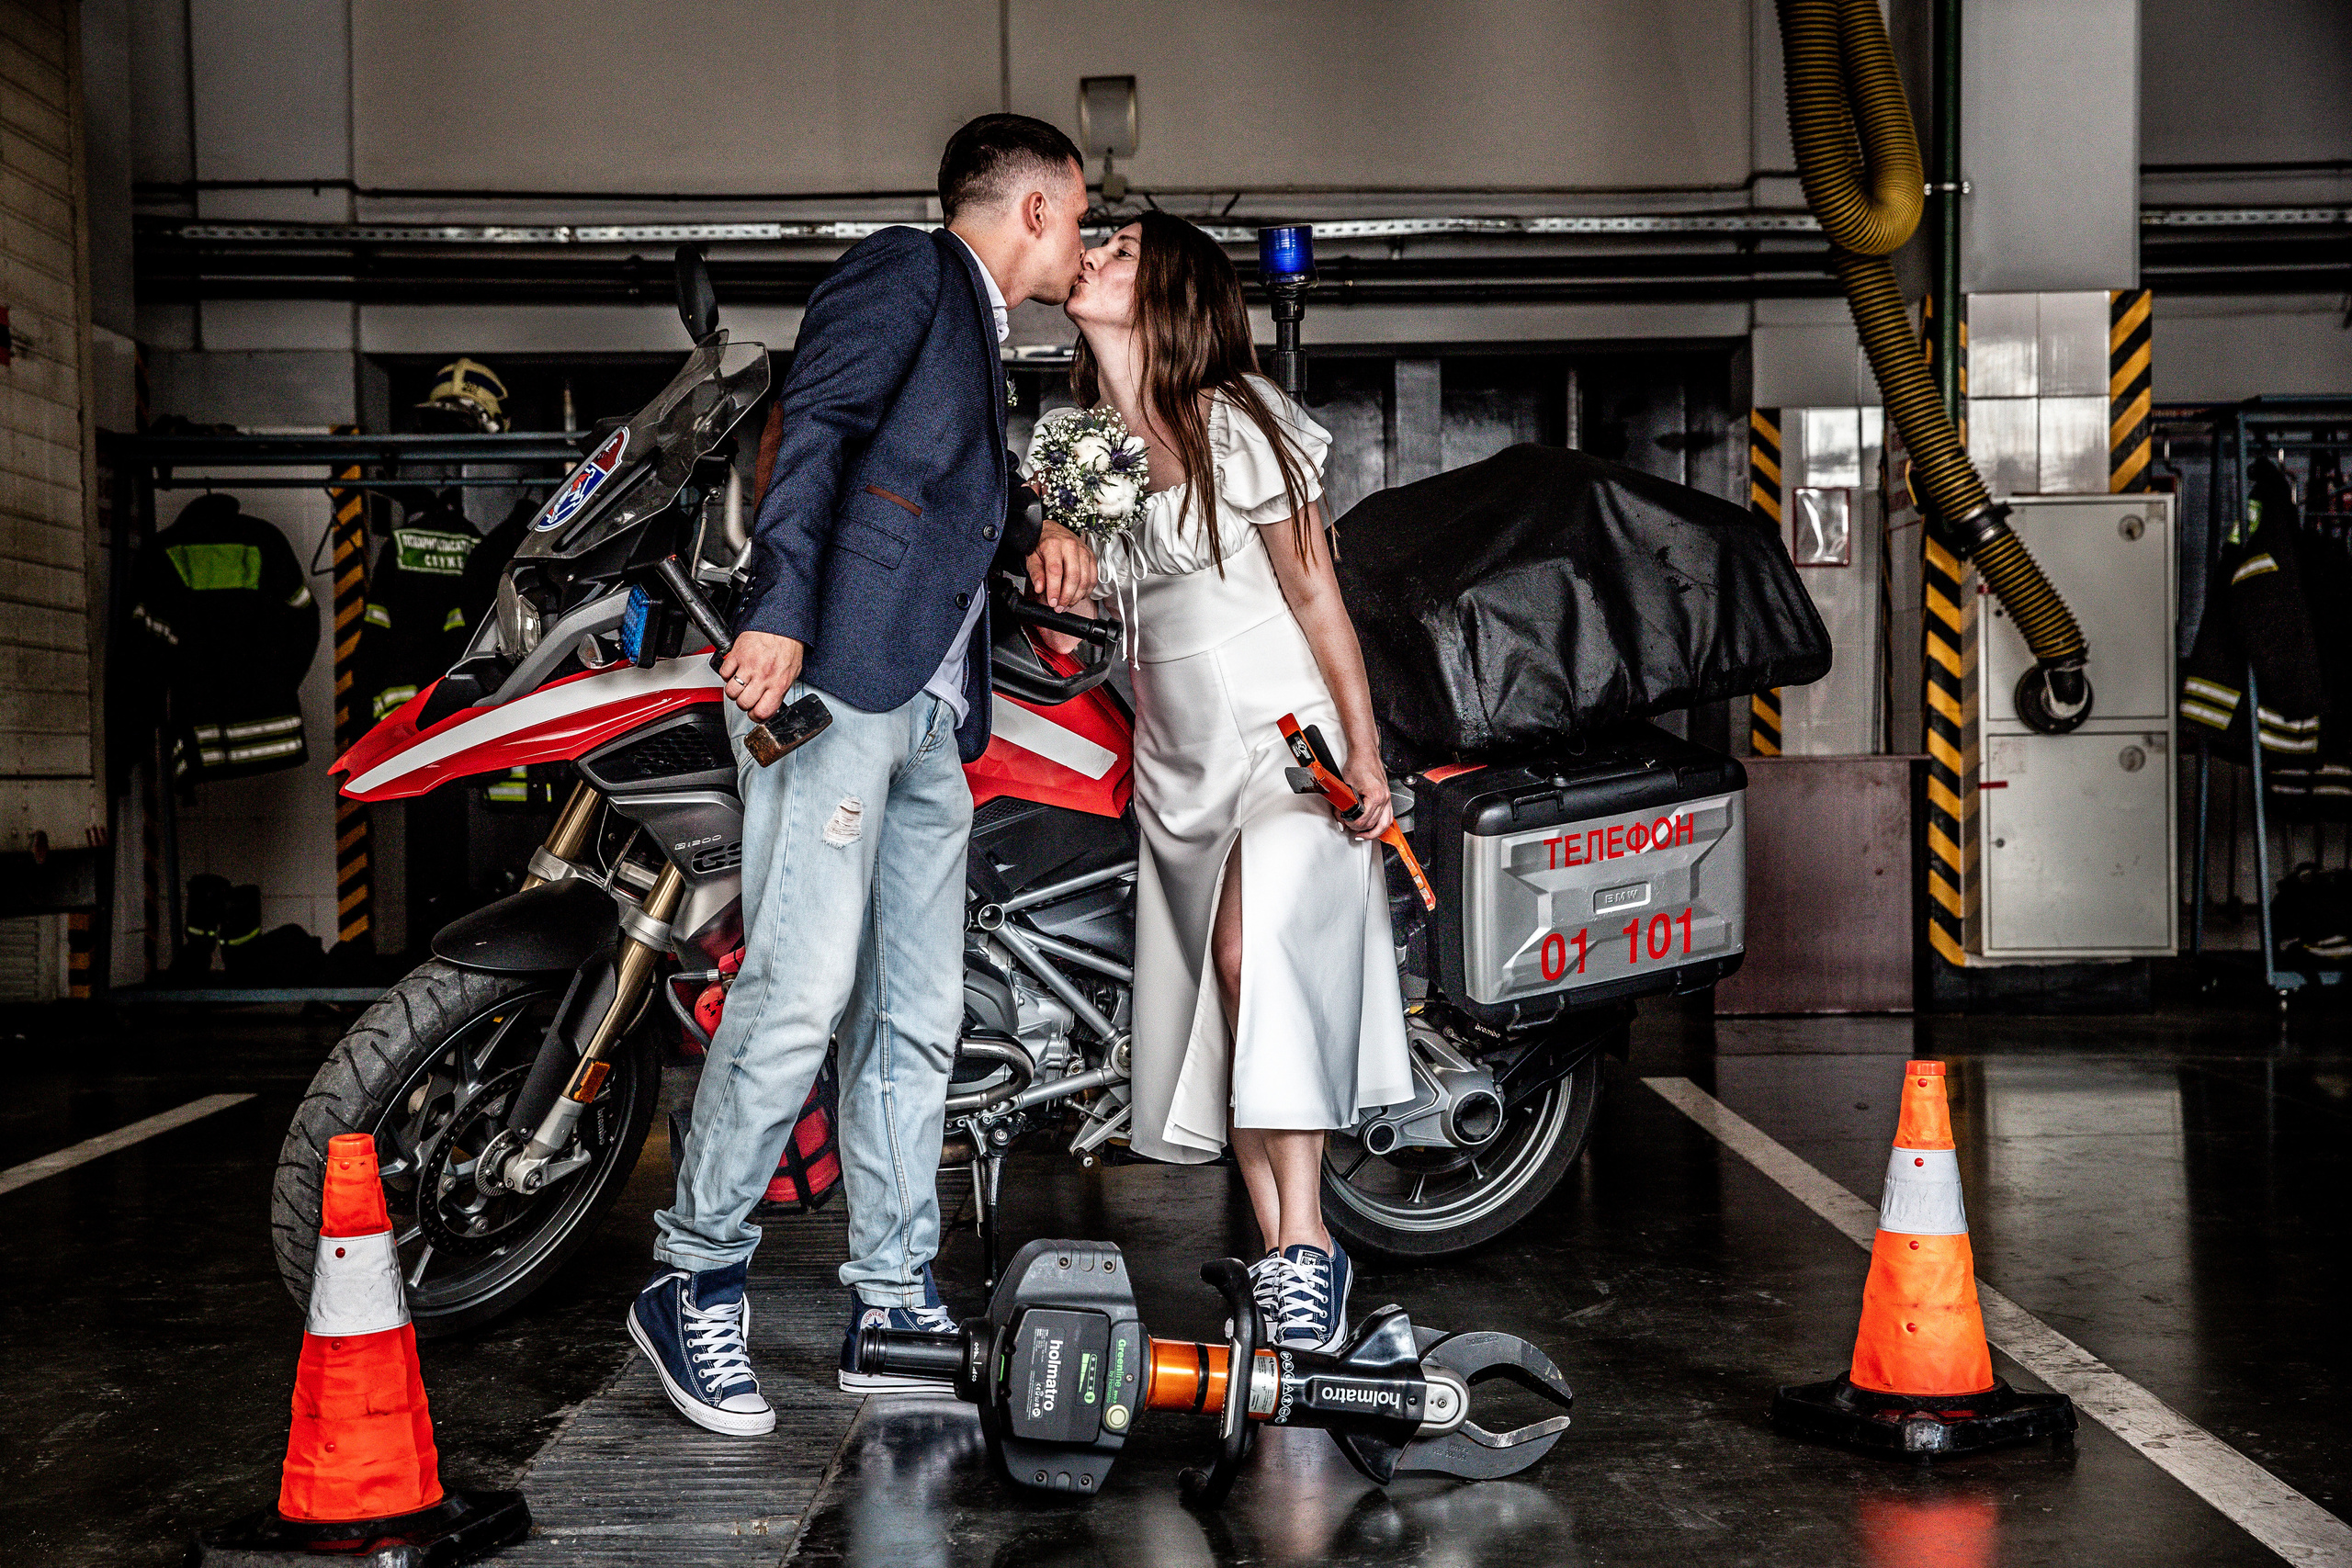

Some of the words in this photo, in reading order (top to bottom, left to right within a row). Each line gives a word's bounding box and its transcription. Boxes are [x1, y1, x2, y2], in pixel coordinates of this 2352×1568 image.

[1543, 813, 1694, 870] ТЕЛЕФОН
[1605, 889, 1638, 904] BMW
[1541, 928, 1588, 981] 01
[1623, 908, 1692, 964] 101
[1475, 1022, 1501, 1039] brembo
[597, 1106, 607, 1145] brembo
[864, 1311, 886, 1324] CONVERS
[1044, 1339, 1064, 1412] holmatro
[1114, 1338, 1127, 1388] Greenline
[1321, 1386, 1401, 1410] holmatro
